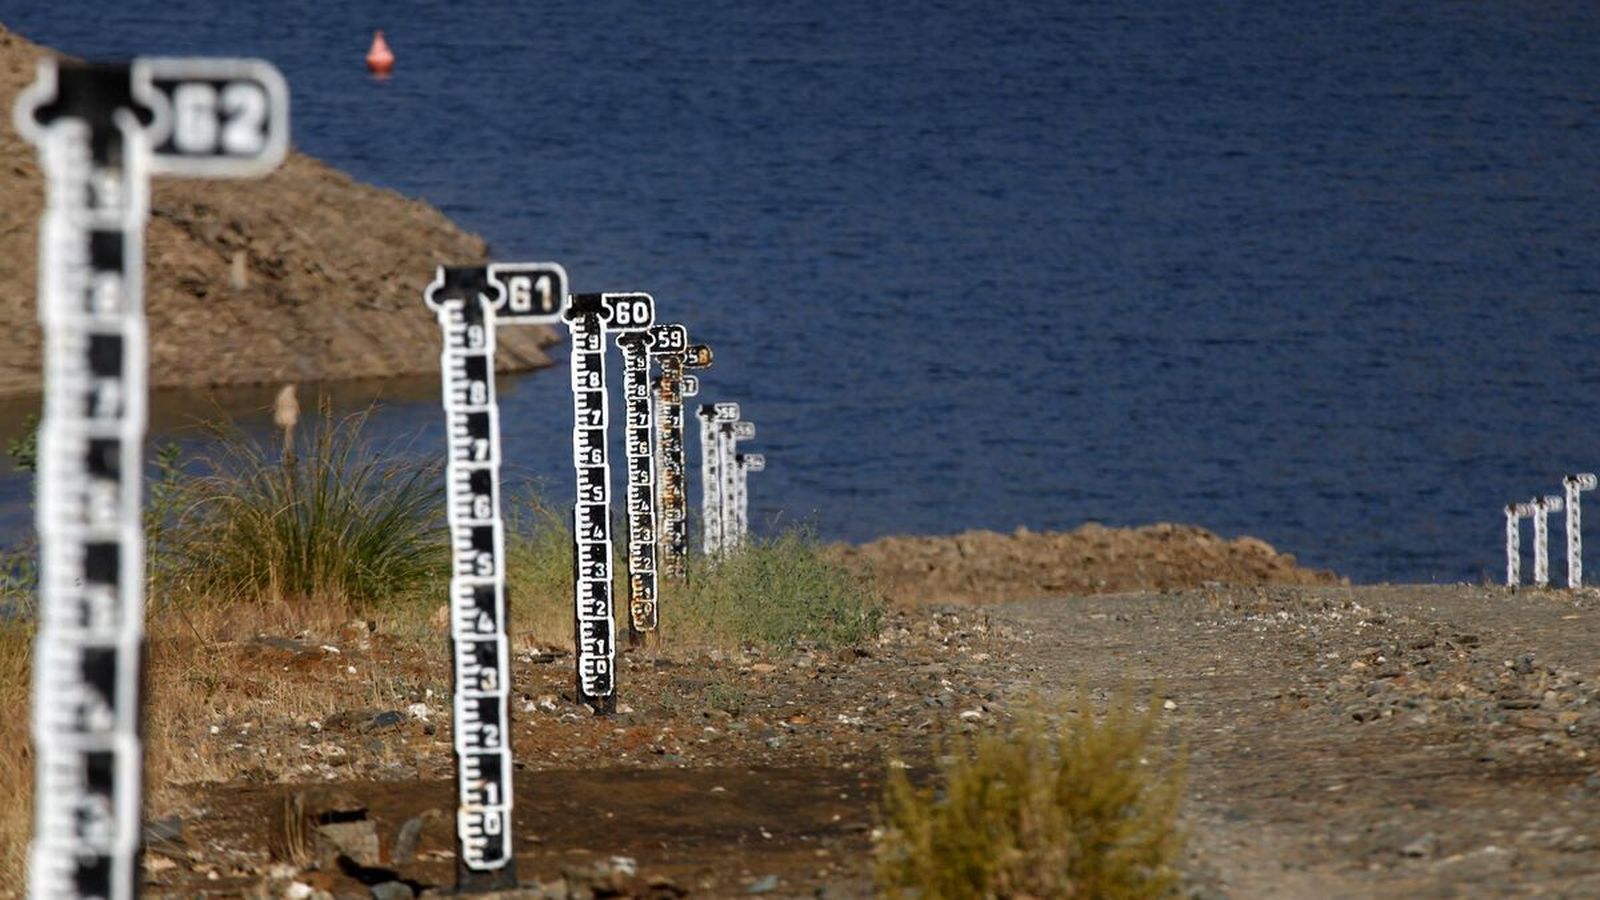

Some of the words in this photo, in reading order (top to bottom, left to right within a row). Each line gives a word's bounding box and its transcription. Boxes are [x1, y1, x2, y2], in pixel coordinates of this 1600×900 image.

[173, 82, 267, 154] 62
[509, 275, 553, 312] 61
[616, 302, 649, 324] 60
[467, 325, 484, 348] 9
[588, 335, 599, 349] 9
[658, 331, 682, 348] 59
[589, 372, 600, 387] 8
[470, 380, 487, 405] 8
[638, 385, 646, 396] 8
[591, 410, 601, 424] 7
[640, 414, 646, 424] 7
[473, 439, 488, 461] 7
[640, 441, 647, 454] 6
[592, 449, 602, 463] 6
[640, 470, 648, 483] 5
[593, 486, 603, 501] 5
[473, 495, 491, 519] 6
[641, 501, 649, 511] 4
[593, 526, 604, 539] 4
[643, 530, 650, 540] 3
[476, 552, 493, 576] 5
[595, 563, 605, 576] 3
[644, 558, 652, 569] 2
[596, 601, 606, 615] 2
[477, 611, 495, 632] 4
[597, 640, 605, 654] 1
[597, 660, 607, 674] 0
[481, 667, 497, 691] 3
[482, 724, 499, 747] 2
[485, 783, 499, 804] 1
[483, 812, 501, 835] 0
